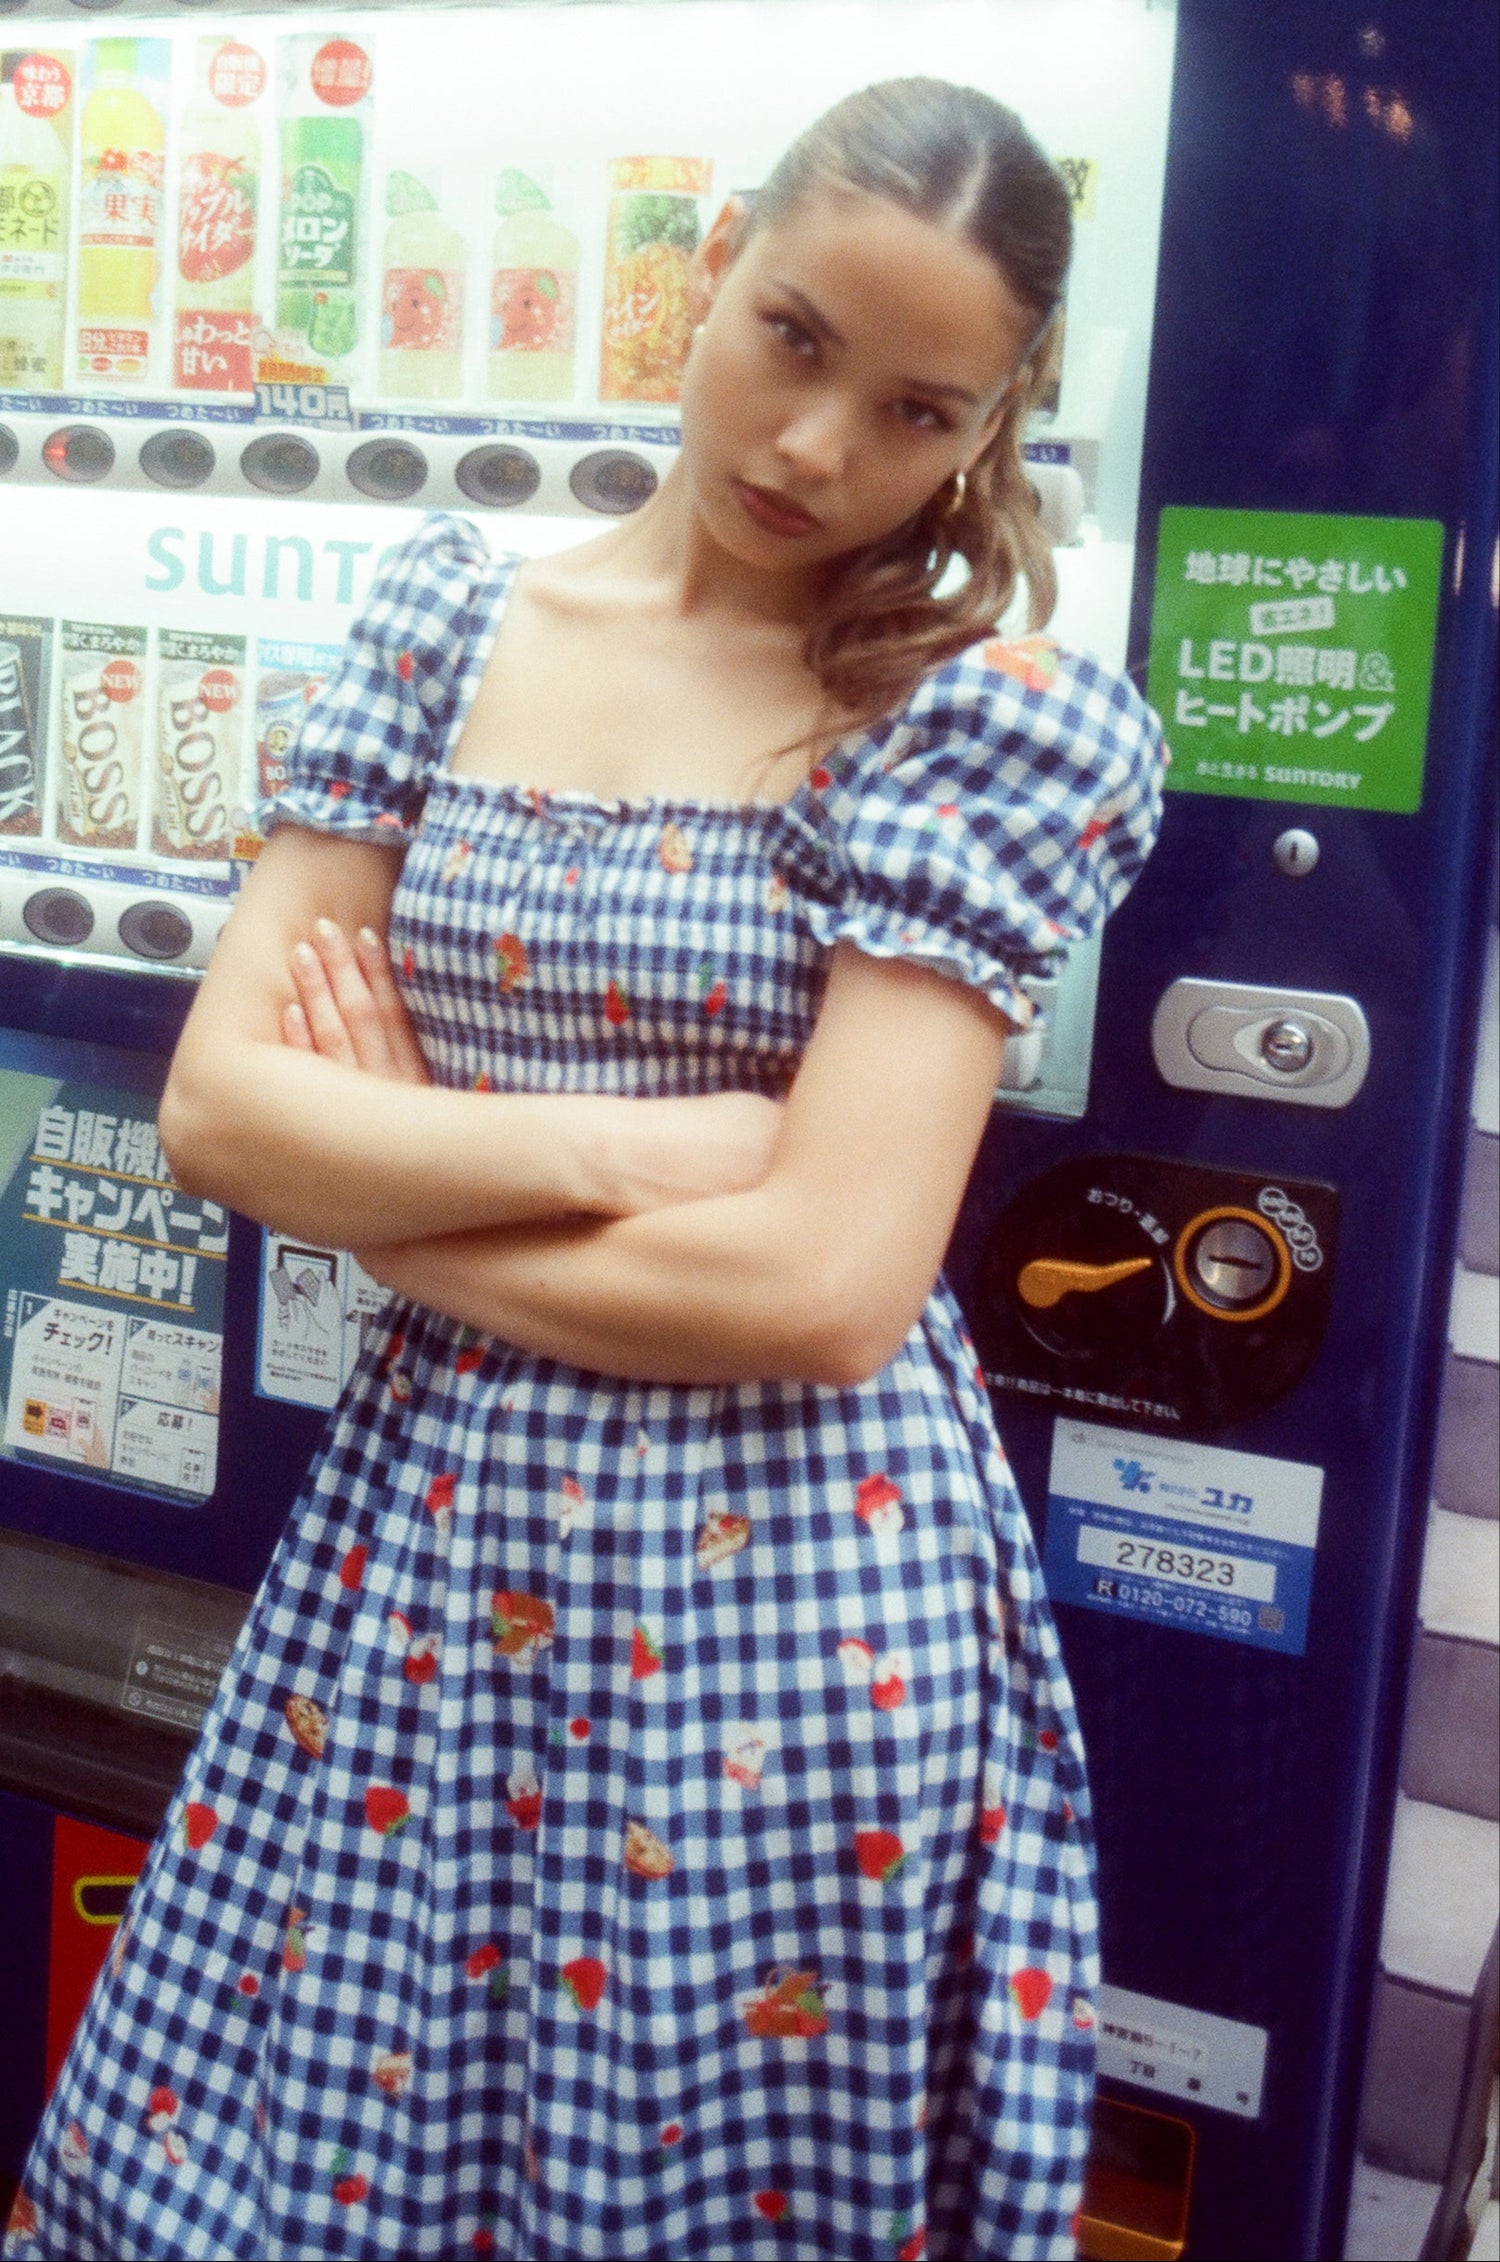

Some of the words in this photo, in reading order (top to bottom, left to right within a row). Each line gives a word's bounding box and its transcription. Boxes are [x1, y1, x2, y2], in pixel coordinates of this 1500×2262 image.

[103, 193, 158, 227] 果実
[281, 216, 347, 242] メロン
[284, 242, 340, 269] ソーダ
[182, 346, 228, 376] 甘い
[255, 383, 349, 418] 140円
[1184, 550, 1408, 594] 地球にやさしい
[101, 674, 140, 688] NEW
[1178, 638, 1395, 692] LED照明&
[200, 684, 238, 698] NEW
[1174, 688, 1396, 742] ヒートポンプ
[73, 686, 130, 825] BOSS
[170, 697, 228, 837] BOSS
[1264, 766, 1363, 790] SUNTORY
[25, 1165, 229, 1254] キャンペーン
[59, 1232, 198, 1306] 実施中!
[53, 1308, 115, 1332] キャンペーンを
[43, 1321, 114, 1356] チェック!
[157, 1411, 194, 1432] 応募!
[1200, 1485, 1254, 1515] ユカ
[1116, 1540, 1236, 1587] 278323
